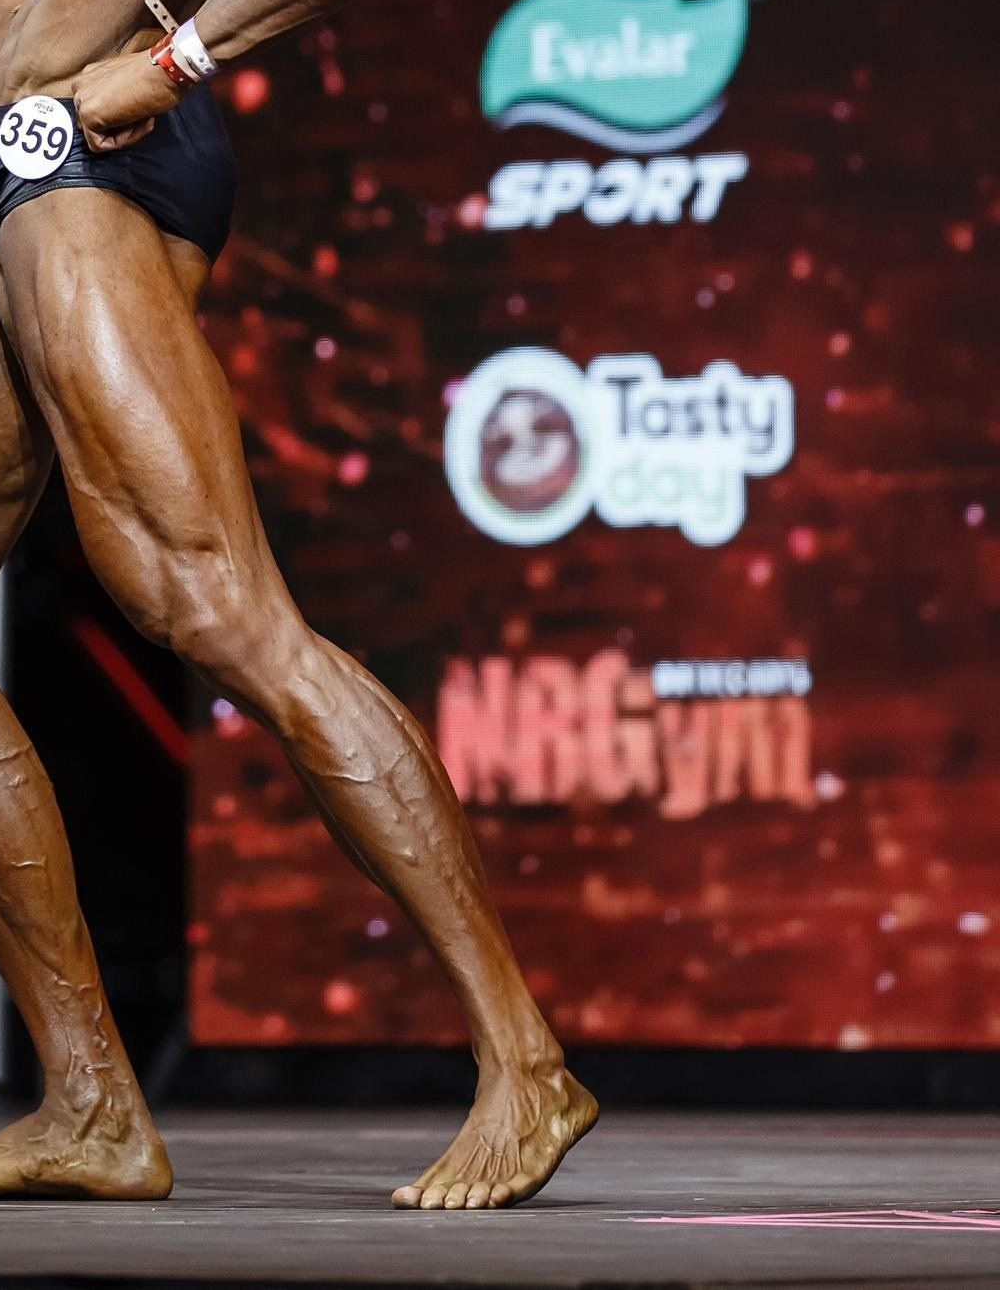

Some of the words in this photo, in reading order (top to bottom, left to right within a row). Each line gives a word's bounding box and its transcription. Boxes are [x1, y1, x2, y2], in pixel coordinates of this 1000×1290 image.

[529, 16, 696, 83] Evalar
[0, 112, 68, 161] 359
[484, 151, 749, 230] SPORT
[604, 373, 778, 456] Tasty
[607, 451, 730, 526] day
